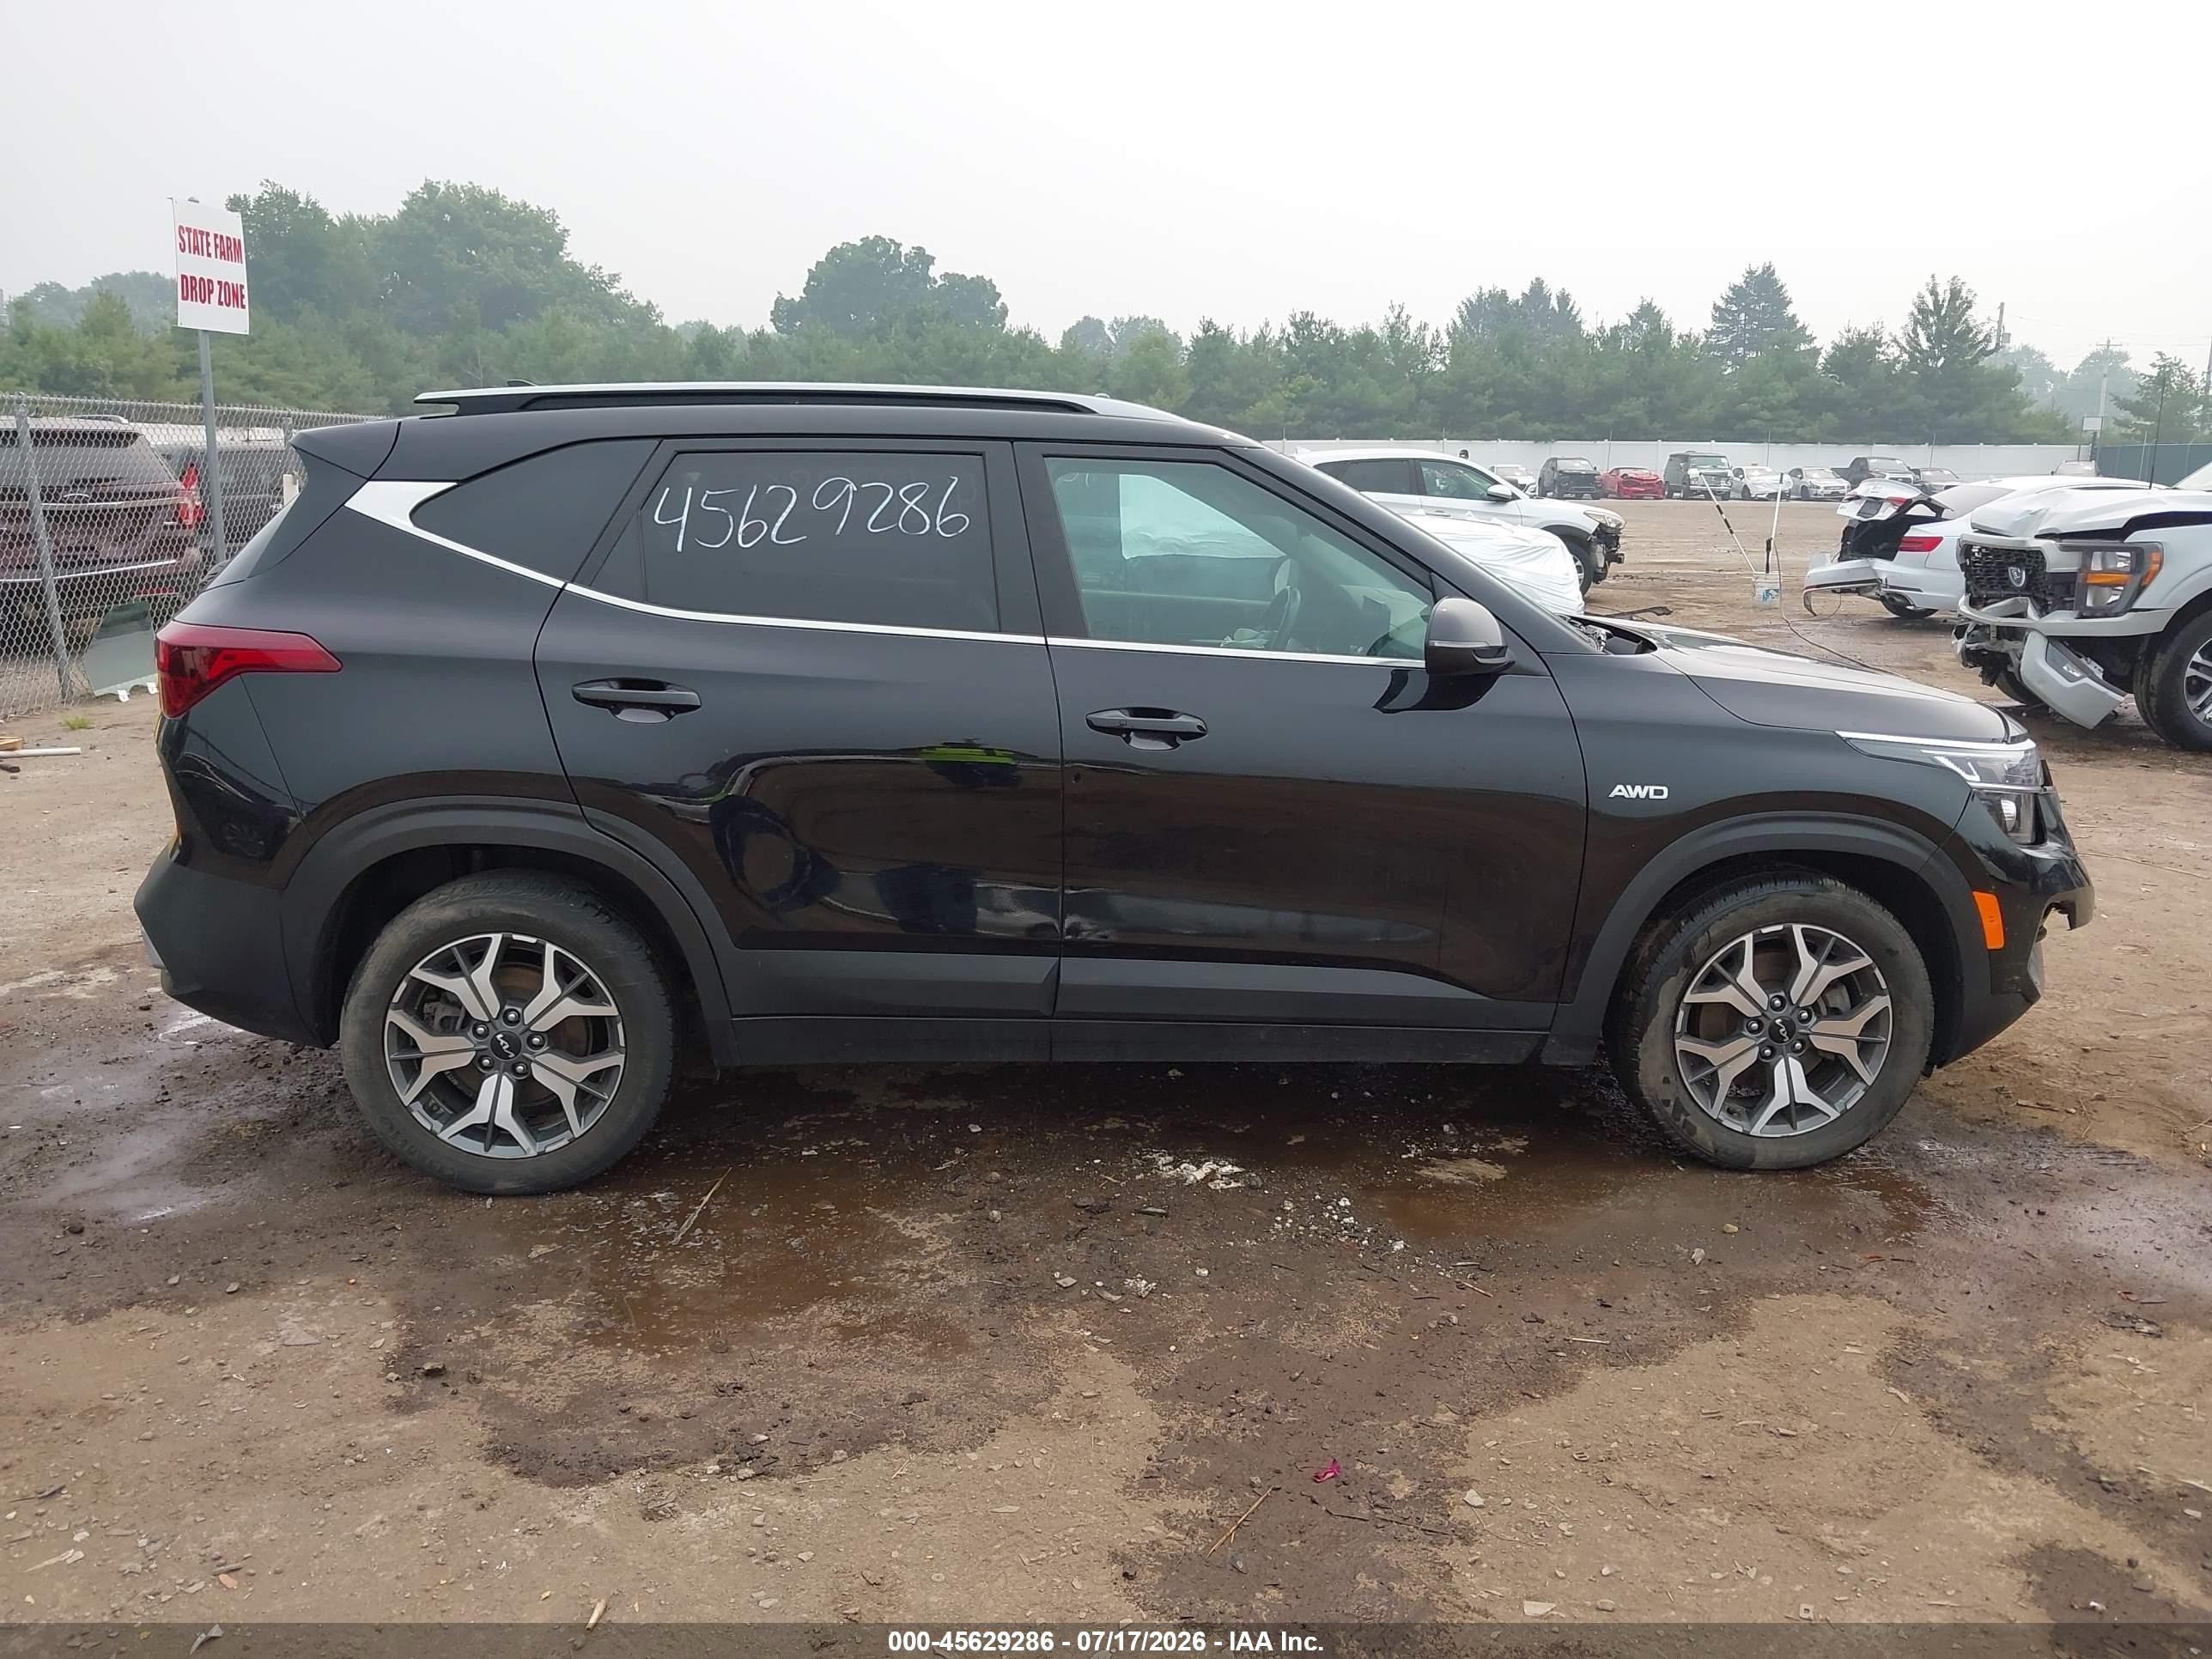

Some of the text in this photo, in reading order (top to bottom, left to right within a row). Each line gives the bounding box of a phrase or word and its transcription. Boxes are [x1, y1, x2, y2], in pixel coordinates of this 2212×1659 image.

[179, 225, 243, 264] STATE FARM
[180, 274, 246, 309] DROP ZONE
[653, 477, 969, 552] 45629286
[1607, 784, 1668, 799] AWD
